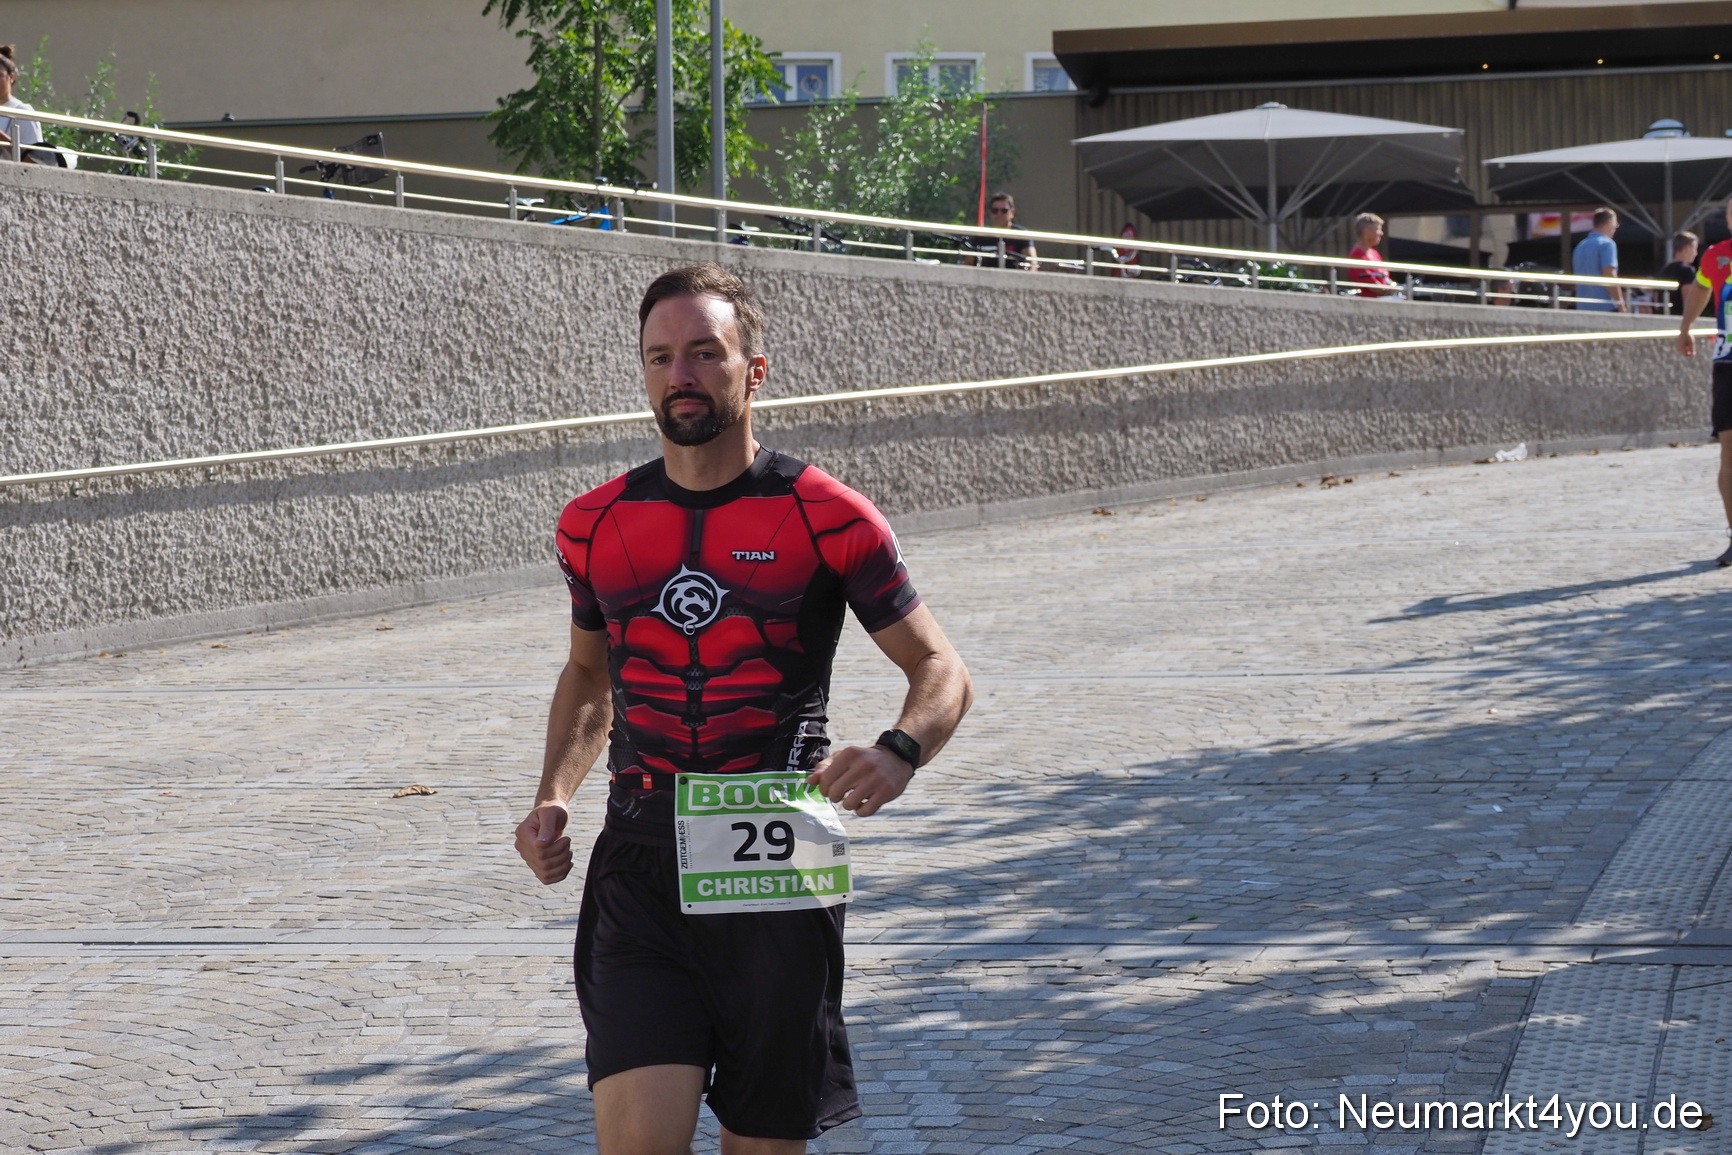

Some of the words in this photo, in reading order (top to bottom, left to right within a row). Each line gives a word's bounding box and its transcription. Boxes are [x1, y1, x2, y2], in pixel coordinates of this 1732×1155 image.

[731, 551, 775, 560] TIAN
[731, 820, 795, 861] 29
[697, 873, 835, 896] CHRISTIAN
